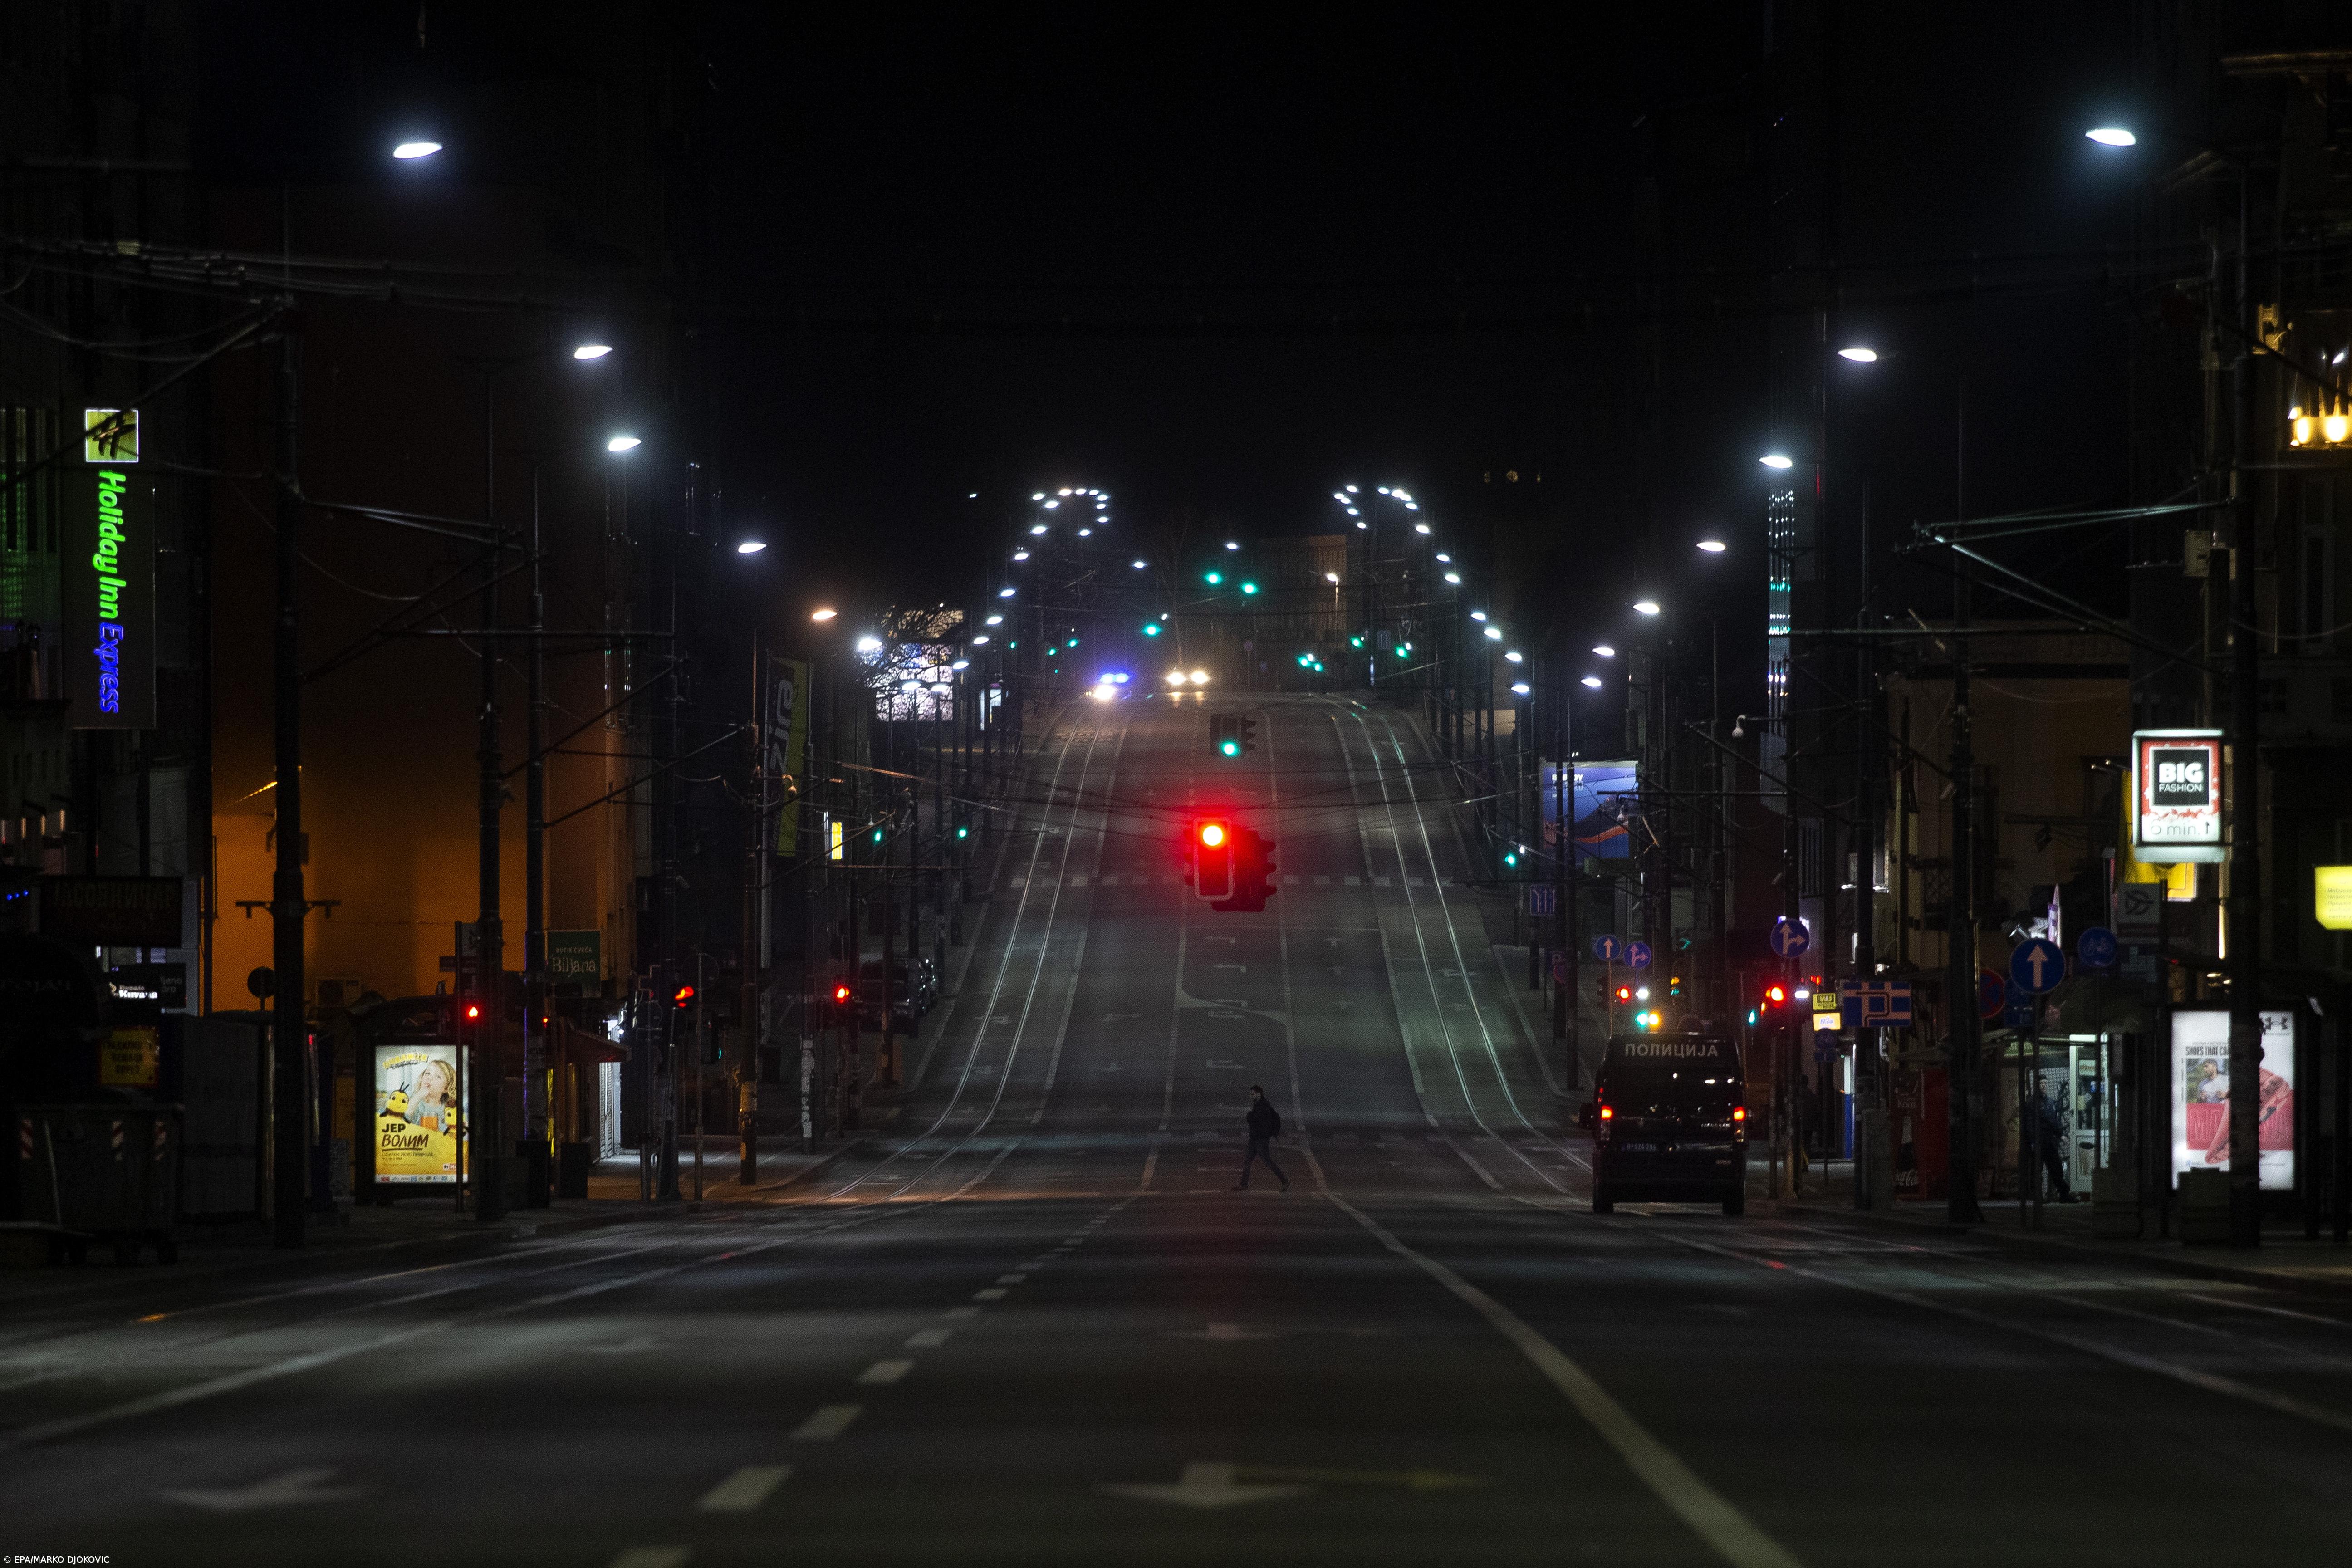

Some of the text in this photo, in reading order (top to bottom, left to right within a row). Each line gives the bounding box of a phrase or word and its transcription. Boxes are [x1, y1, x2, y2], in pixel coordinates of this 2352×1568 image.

[92, 470, 127, 714] Holiday Inn Express
[2158, 762, 2204, 784] BIG
[2158, 783, 2202, 793] FASHION
[552, 957, 596, 978] Biljana
[1625, 1043, 1718, 1058] ПОЛИЦИЈА
[2185, 1046, 2204, 1056] SHOES
[2205, 1046, 2218, 1056] THAT
[382, 1123, 406, 1132] ЈЕР
[381, 1134, 429, 1148] ВОЛИМ
